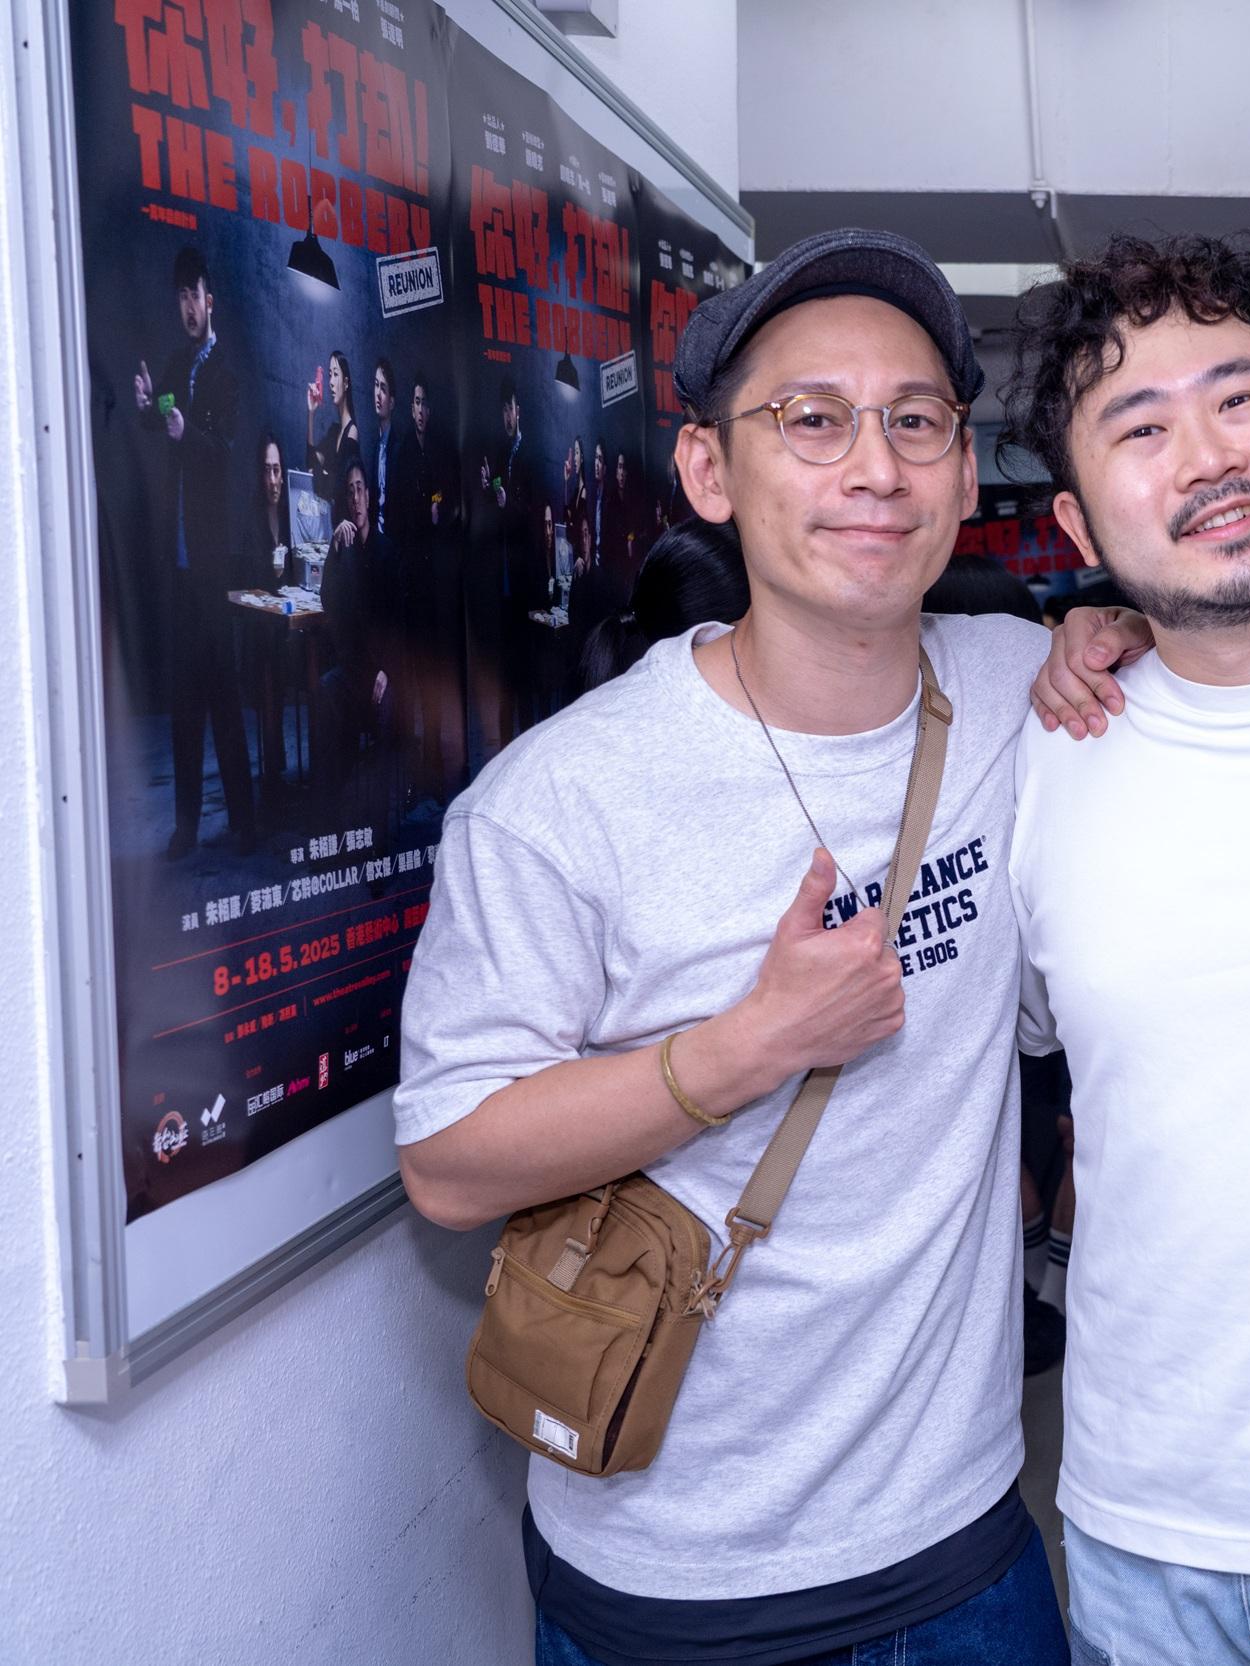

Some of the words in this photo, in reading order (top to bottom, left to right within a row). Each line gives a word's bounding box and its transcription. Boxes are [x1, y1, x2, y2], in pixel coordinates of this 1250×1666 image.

[131, 103, 238, 212] THE
[248, 146, 431, 255] ROBBERY
[388, 266, 434, 297] REUNION
[476, 284, 531, 346] THE
[535, 297, 632, 362] ROBBERY
[606, 366, 632, 391] REUNION
[822, 892, 859, 931] EW
[865, 837, 989, 908] BANCE
[895, 888, 978, 949] ETICS
[917, 938, 959, 971] 1906
[344, 1050, 359, 1066] blue
